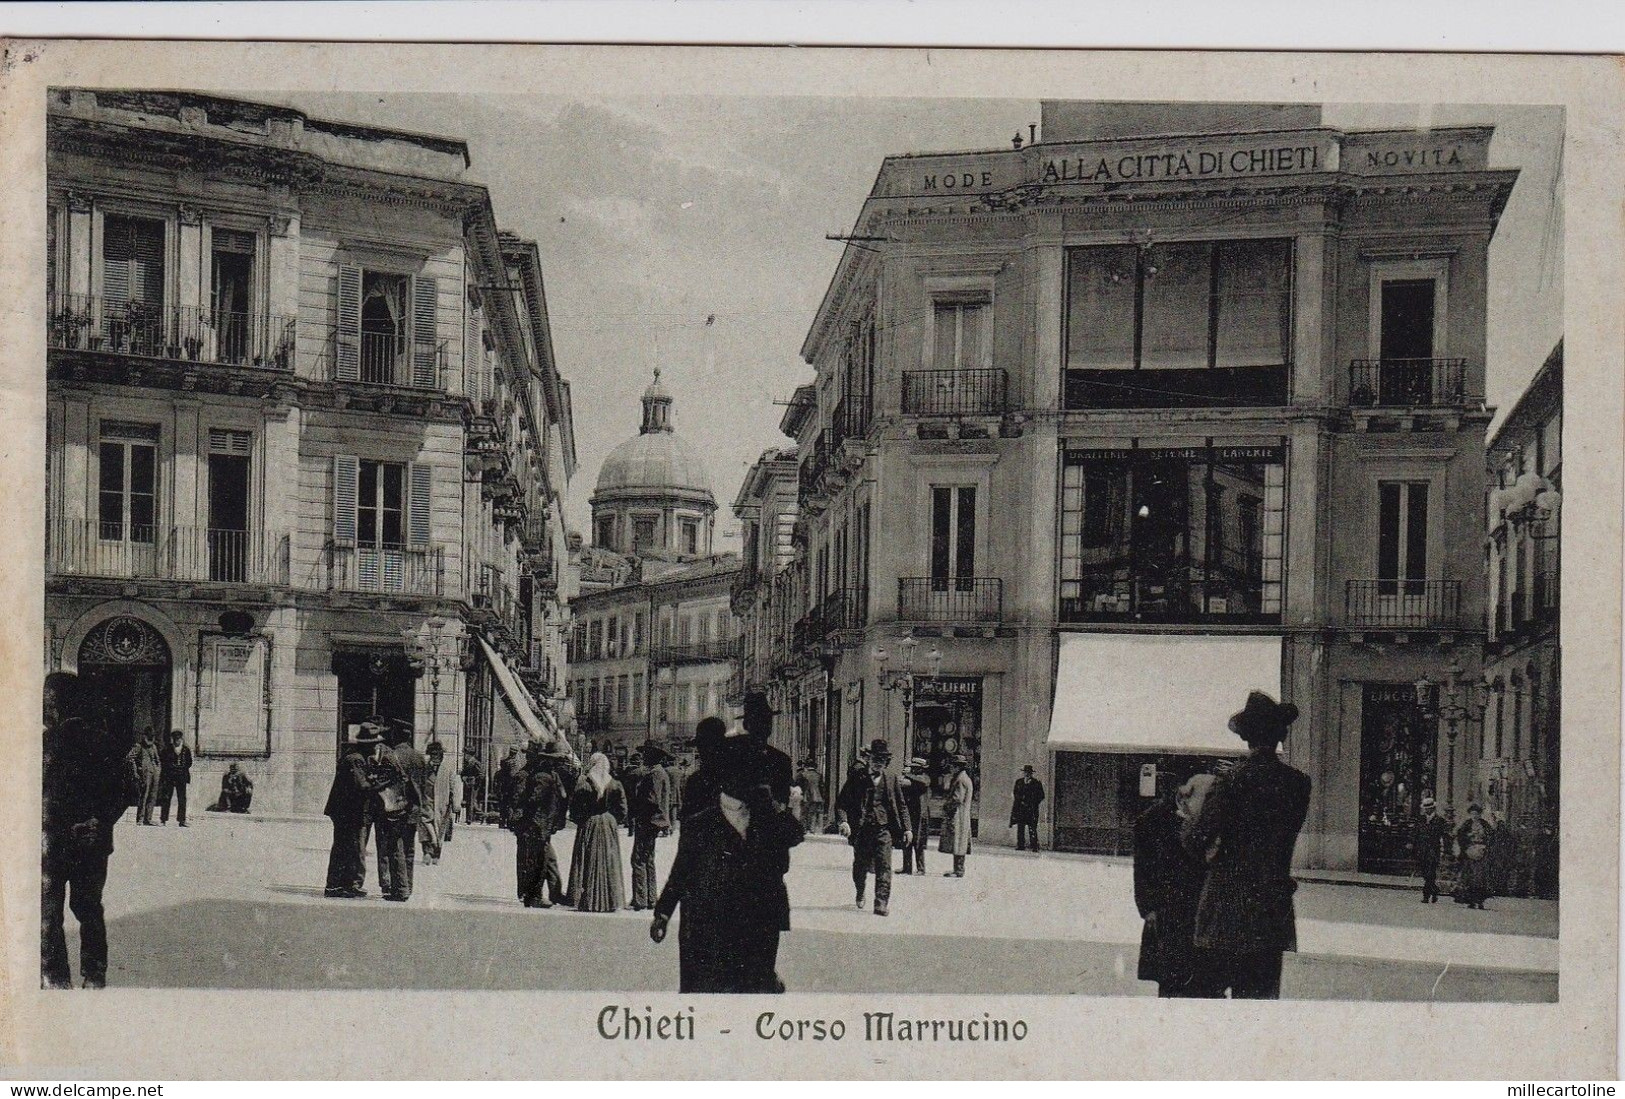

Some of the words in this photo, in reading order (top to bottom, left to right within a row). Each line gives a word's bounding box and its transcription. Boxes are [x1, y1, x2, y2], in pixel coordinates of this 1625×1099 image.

[1042, 157, 1112, 183] ALLA
[1117, 150, 1193, 179] CITTÀ
[1199, 151, 1223, 175] DI
[1230, 146, 1318, 173] CHIETI
[924, 171, 993, 190] MODE
[919, 681, 977, 693] GLIERIE
